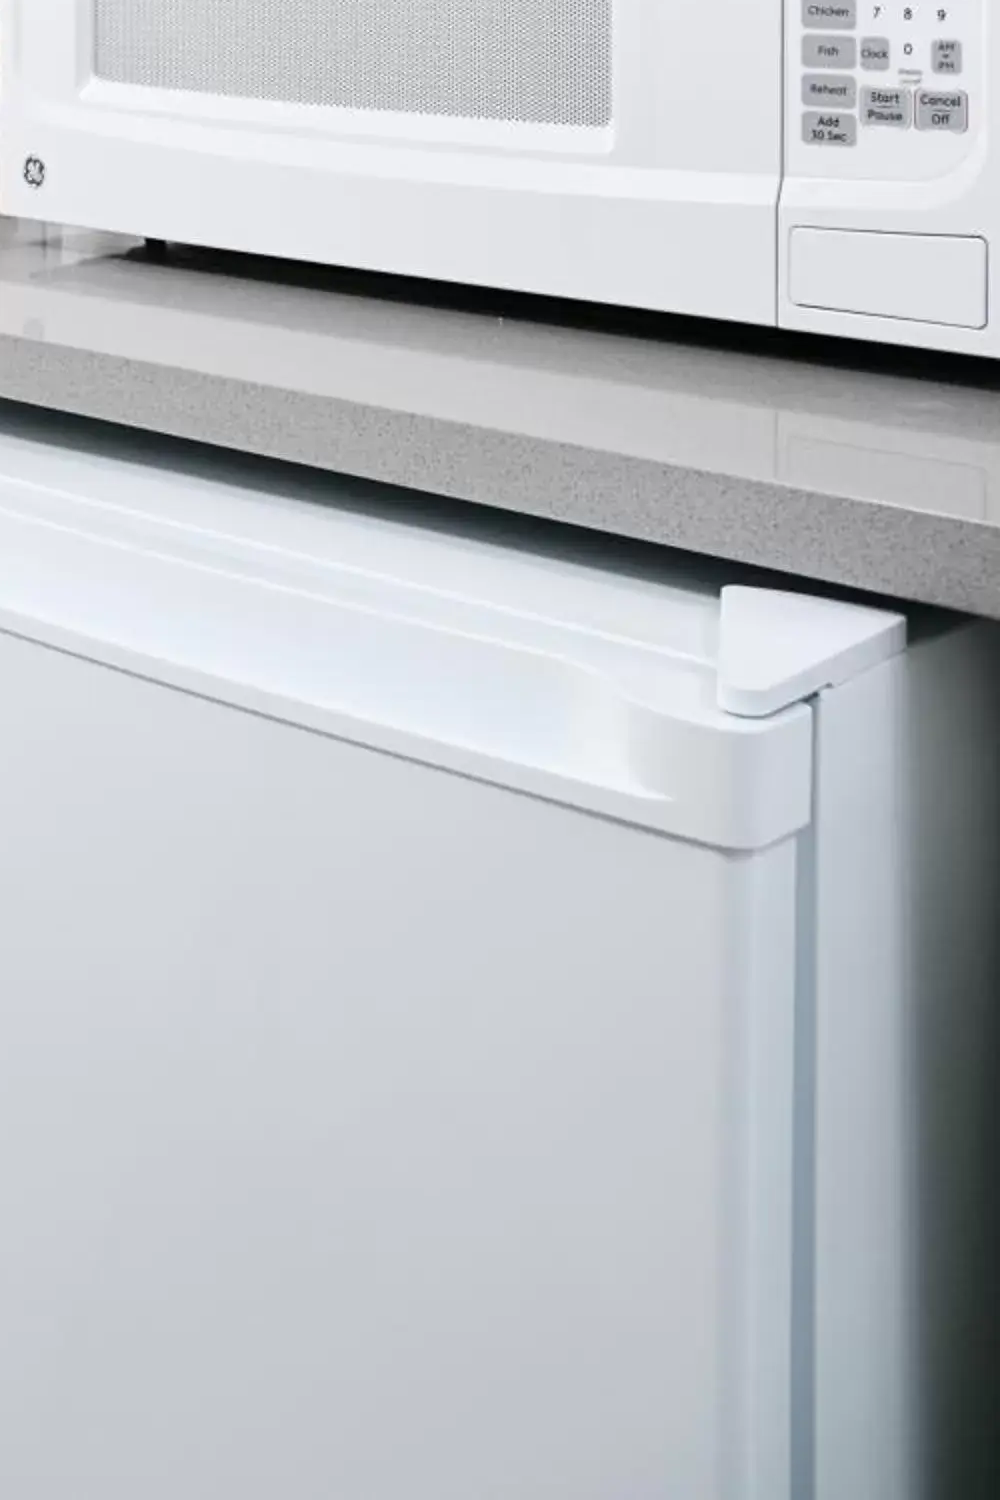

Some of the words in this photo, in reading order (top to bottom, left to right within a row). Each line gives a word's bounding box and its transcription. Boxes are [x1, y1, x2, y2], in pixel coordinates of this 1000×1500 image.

[807, 5, 849, 17] Chicken
[873, 6, 880, 18] 7
[903, 7, 912, 21] 8
[937, 9, 946, 22] 9
[817, 45, 839, 57] Fish
[903, 43, 913, 55] 0
[810, 84, 847, 96] Reheat
[871, 91, 900, 103] Start
[920, 94, 961, 107] Cancel
[817, 116, 840, 128] Add
[867, 110, 903, 122] Pause
[931, 113, 950, 125] Off
[811, 129, 825, 140] 30
